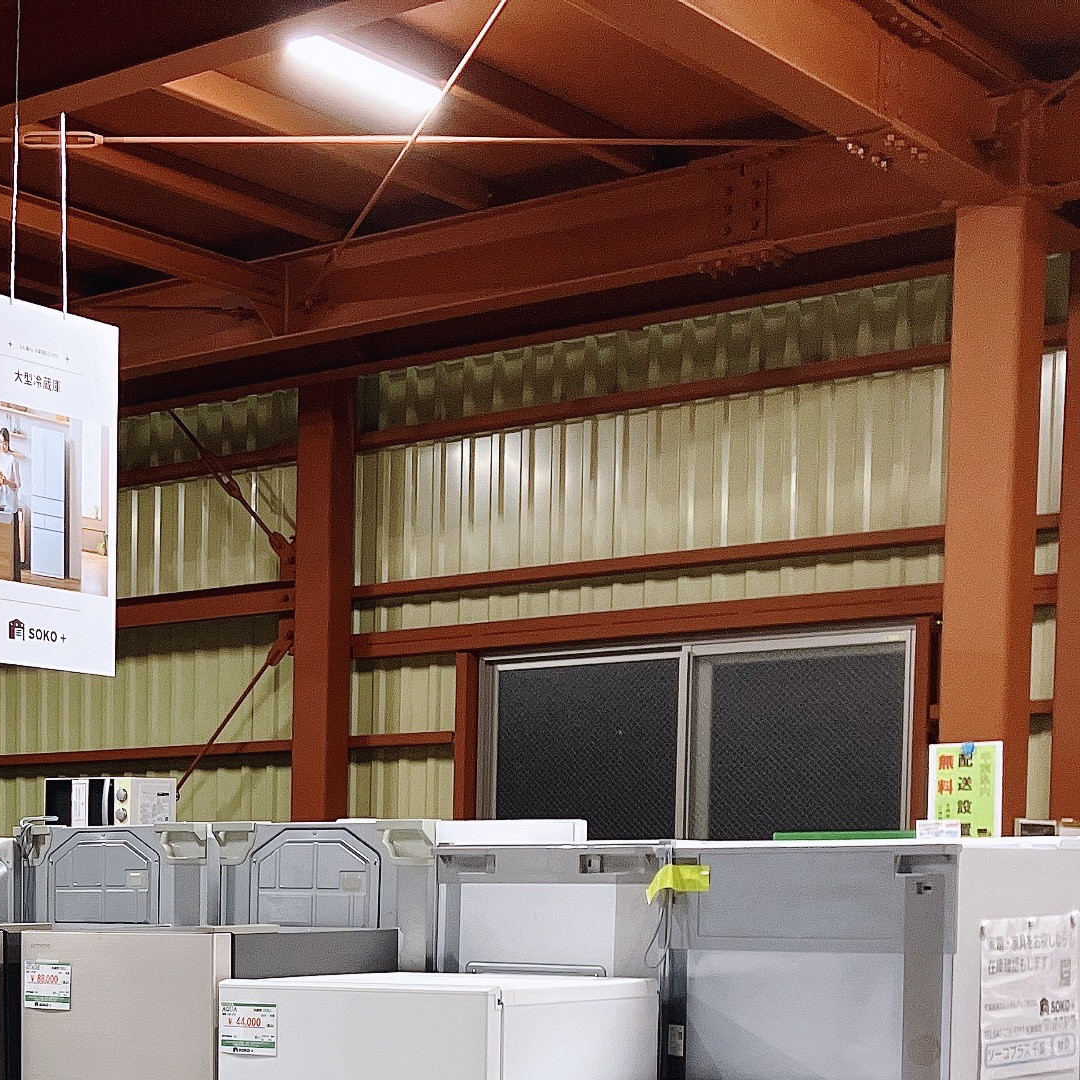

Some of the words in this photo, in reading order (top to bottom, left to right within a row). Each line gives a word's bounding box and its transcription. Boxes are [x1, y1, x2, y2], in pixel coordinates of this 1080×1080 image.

[14, 369, 62, 393] 大型冷蔵庫
[28, 627, 58, 642] SOKO
[937, 755, 954, 795] 無料
[236, 1016, 261, 1027] 44,000
